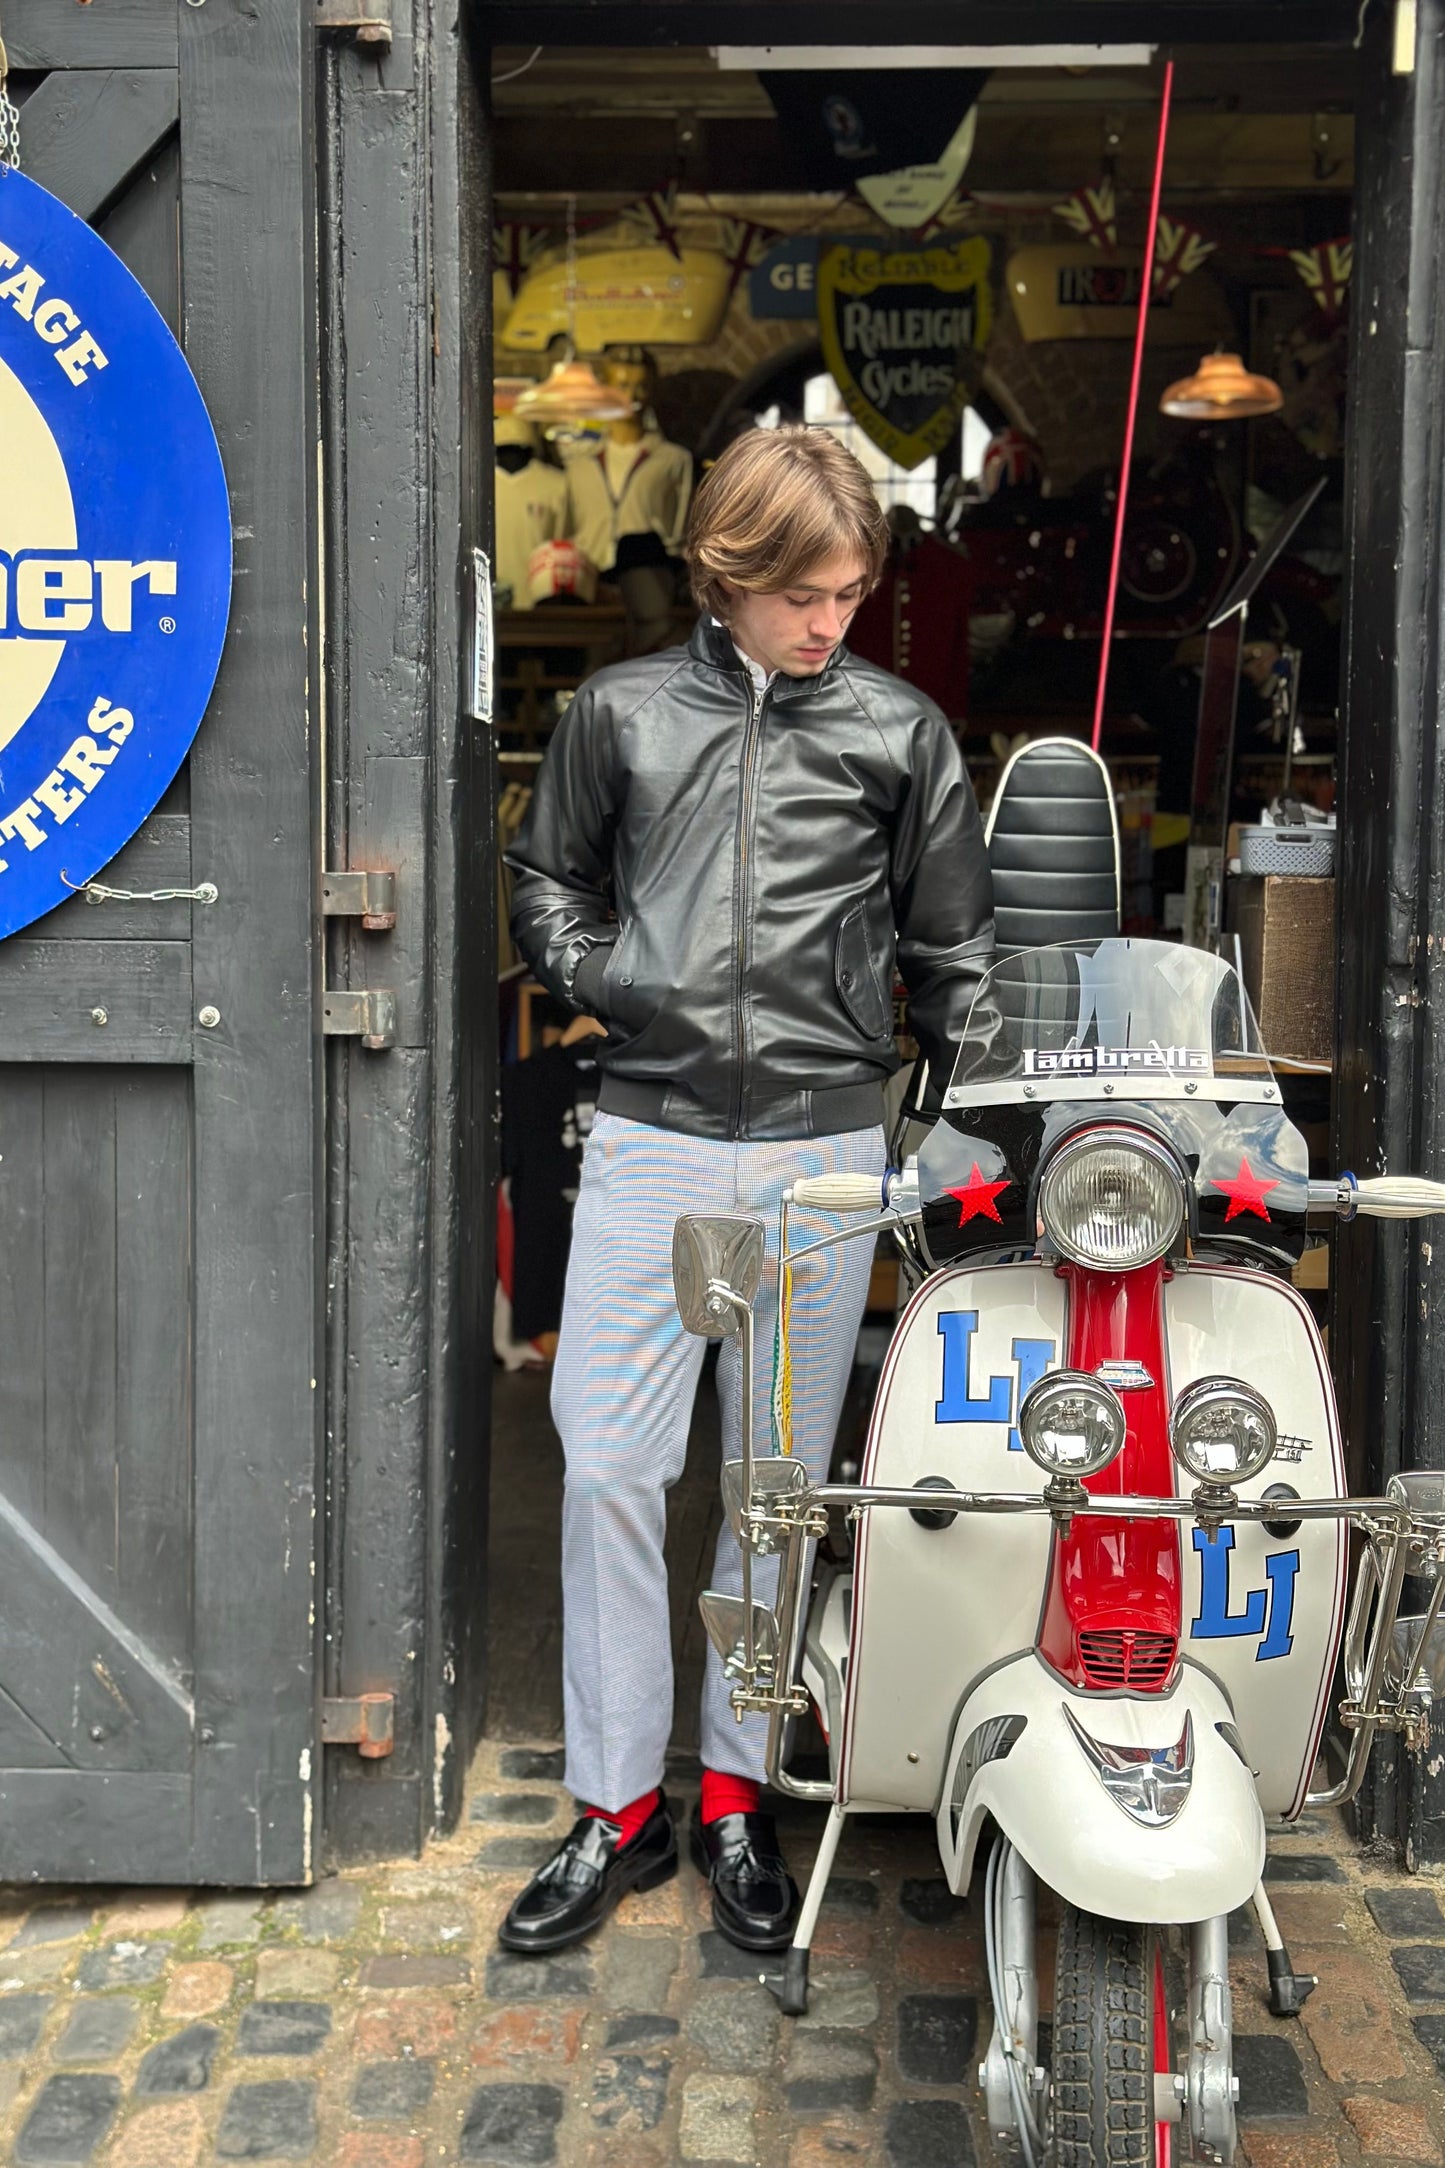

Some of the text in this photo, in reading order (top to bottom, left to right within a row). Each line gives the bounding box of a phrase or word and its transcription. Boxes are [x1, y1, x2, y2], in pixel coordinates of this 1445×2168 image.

[844, 301, 972, 358] RALEIGH
[861, 359, 955, 408] Cycles
[1022, 1045, 1209, 1075] Lambretta
